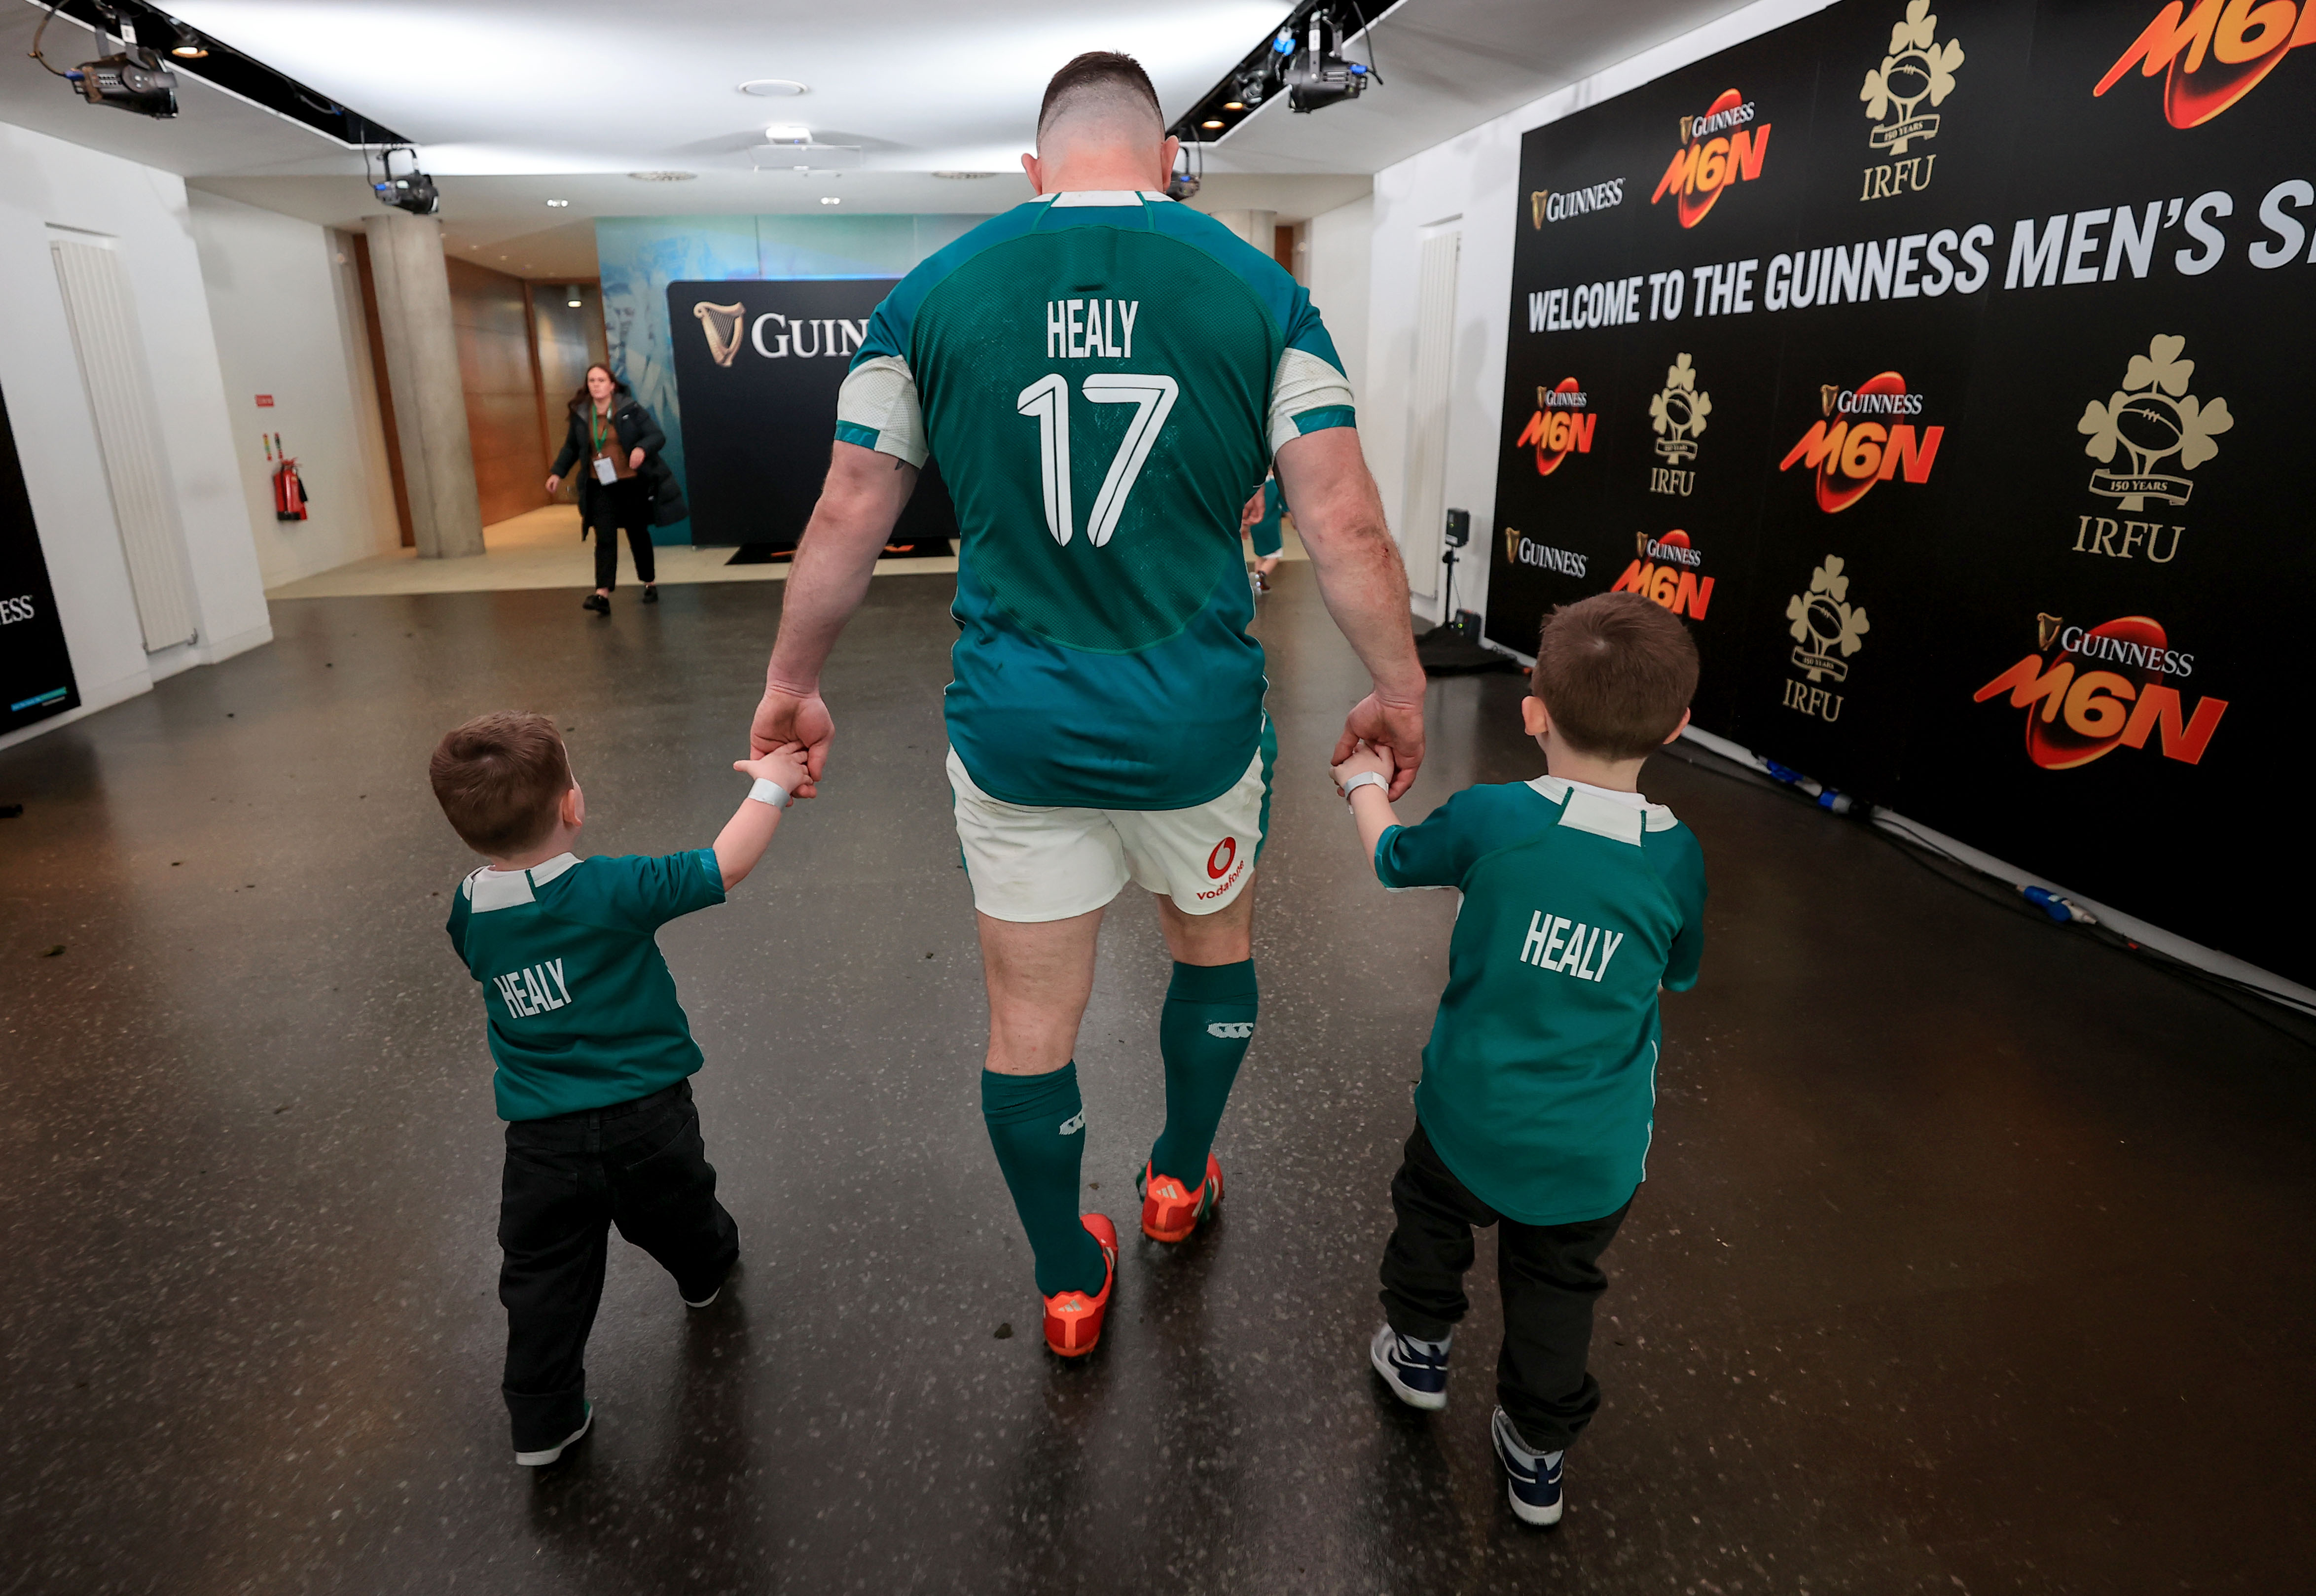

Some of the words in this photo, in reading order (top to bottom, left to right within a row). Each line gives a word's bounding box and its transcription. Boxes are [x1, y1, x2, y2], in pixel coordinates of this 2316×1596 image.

[1691, 102, 1755, 138] GUINNESS
[1651, 123, 1772, 205] M6N
[1859, 154, 1937, 201] IRFU
[1546, 177, 1624, 222] GUINNESS
[1528, 276, 1643, 333] WELCOME
[1649, 270, 1684, 321] TO
[1692, 259, 1759, 318] THE
[1765, 223, 1994, 311] GUINNESS
[2004, 191, 2234, 289] MEN'S
[1047, 299, 1139, 358] HEALY
[1545, 390, 1587, 407] GUINNESS
[1838, 390, 1923, 414] GUINNESS
[1517, 410, 1597, 453] M6N
[1779, 420, 1945, 484] M6N
[1017, 373, 1179, 548] 17
[1649, 467, 1696, 497] IRFU
[2110, 481, 2129, 491] 150
[2132, 481, 2168, 491] YEARS
[1519, 537, 1587, 579] GUINNESS
[1646, 538, 1701, 567] GUINNESS
[2072, 515, 2186, 563] IRFU
[1610, 559, 1715, 621] M6N
[2061, 626, 2194, 677] GUINNESS
[1782, 678, 1844, 722] IRFU
[1974, 654, 2229, 765] M6N
[1196, 860, 1244, 900] vodafone
[1520, 910, 1624, 983] HEALY
[493, 958, 572, 1019] HEALY
